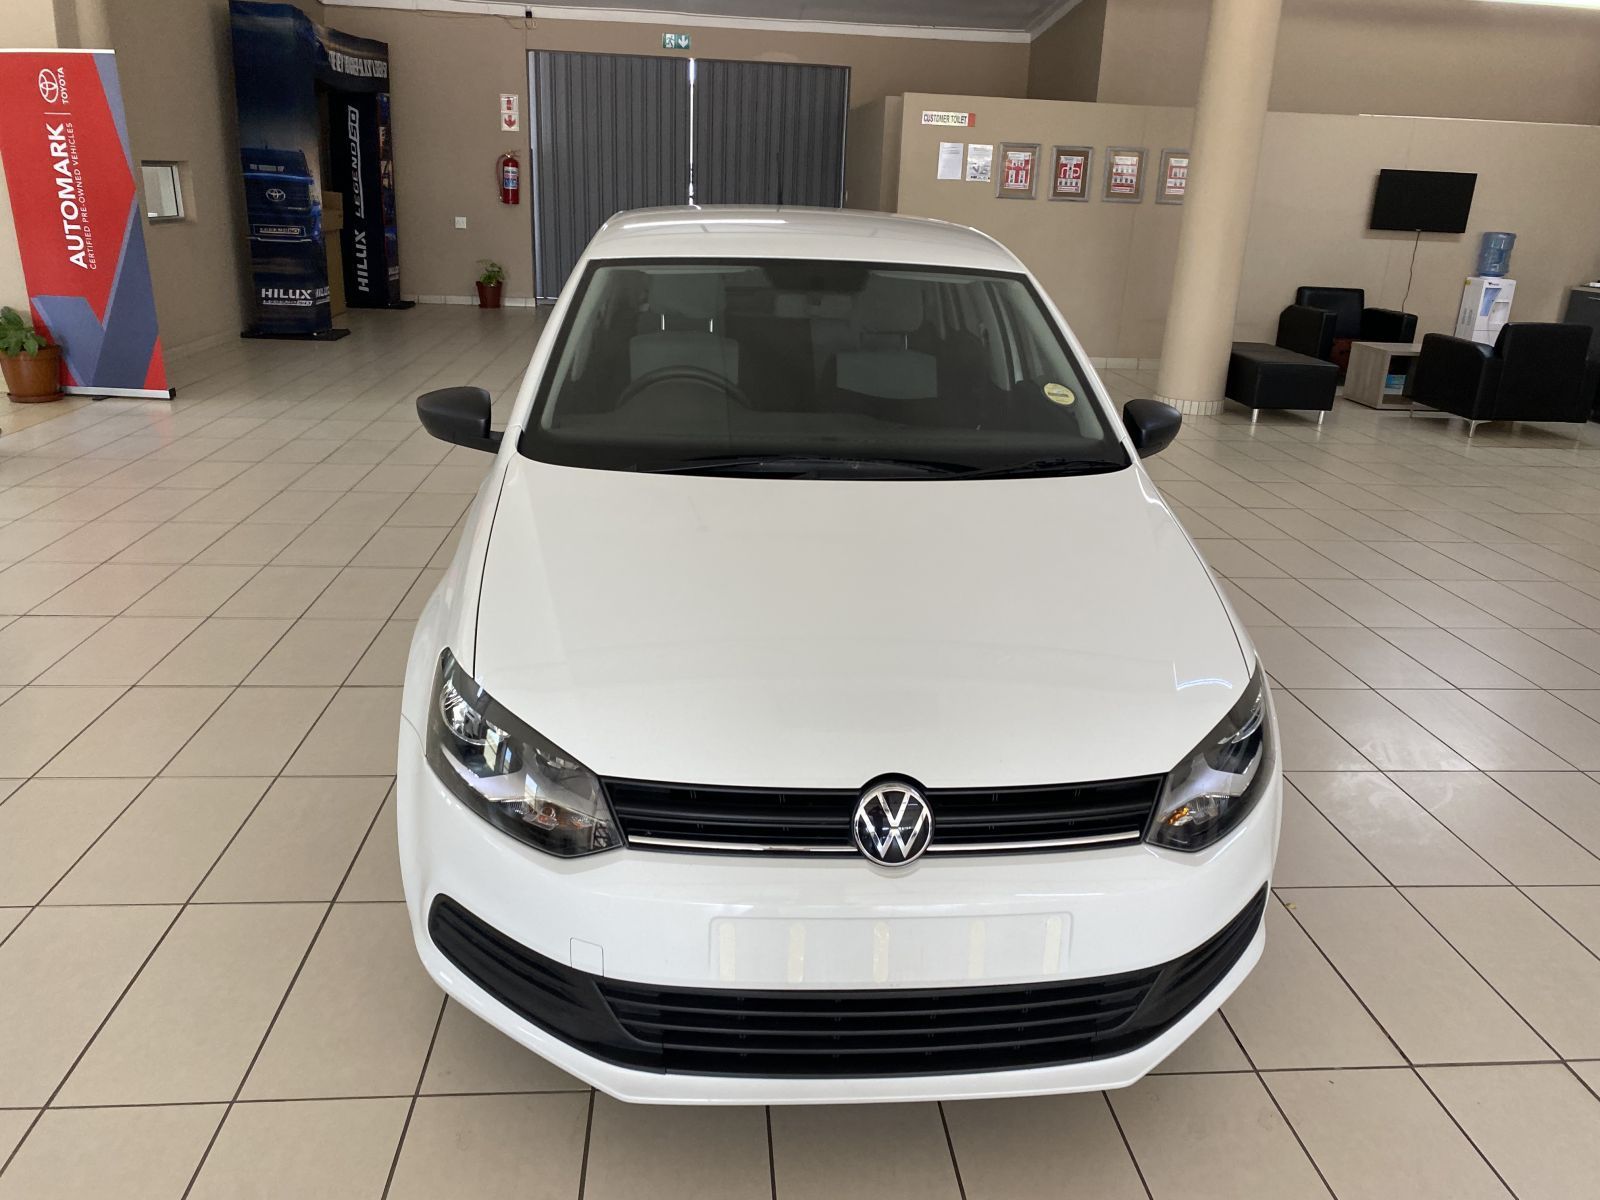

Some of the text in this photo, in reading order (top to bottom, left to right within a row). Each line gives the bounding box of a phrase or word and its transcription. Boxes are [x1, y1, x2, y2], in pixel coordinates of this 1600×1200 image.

[57, 66, 69, 104] TOYOTA
[923, 114, 967, 124] CUSTOMER TOILET
[45, 123, 88, 269] AUTOMARK
[66, 122, 97, 270] CERTIFIED PRE-OWNED VEHICLES
[354, 229, 370, 292] HILUX
[261, 288, 313, 299] HILUX
